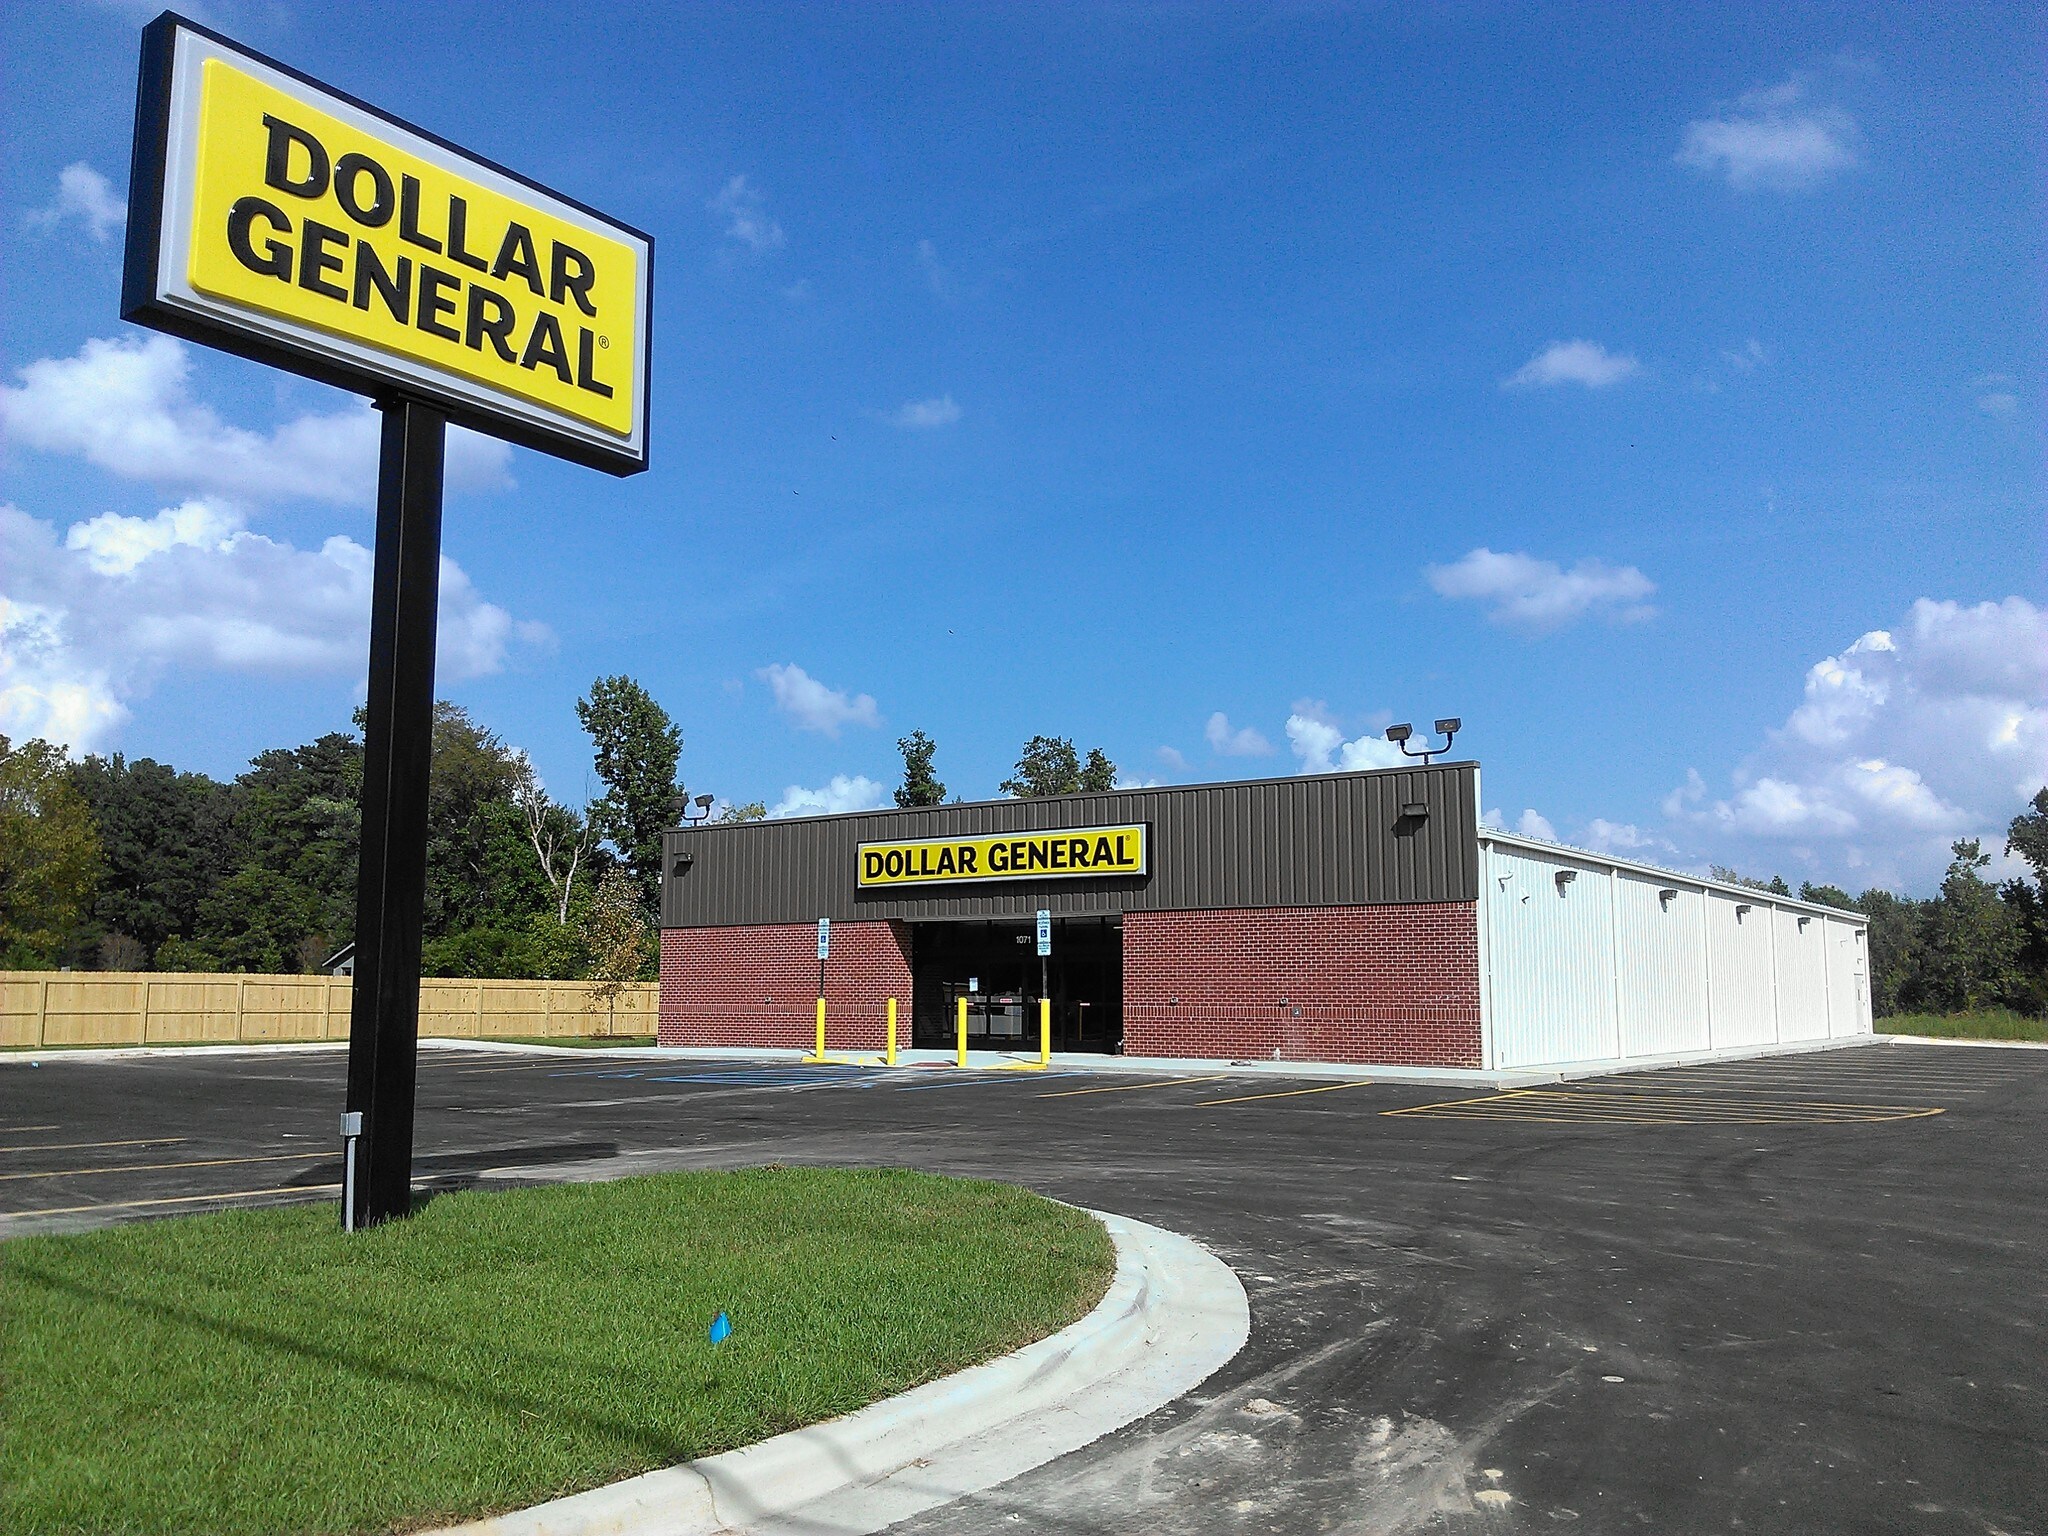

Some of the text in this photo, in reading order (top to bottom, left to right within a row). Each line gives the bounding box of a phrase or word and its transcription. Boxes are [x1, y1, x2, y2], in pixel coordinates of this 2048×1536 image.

[226, 196, 614, 400] GENERAL
[262, 112, 597, 317] DOLLAR
[864, 835, 1135, 879] DOLLAR GENERAL
